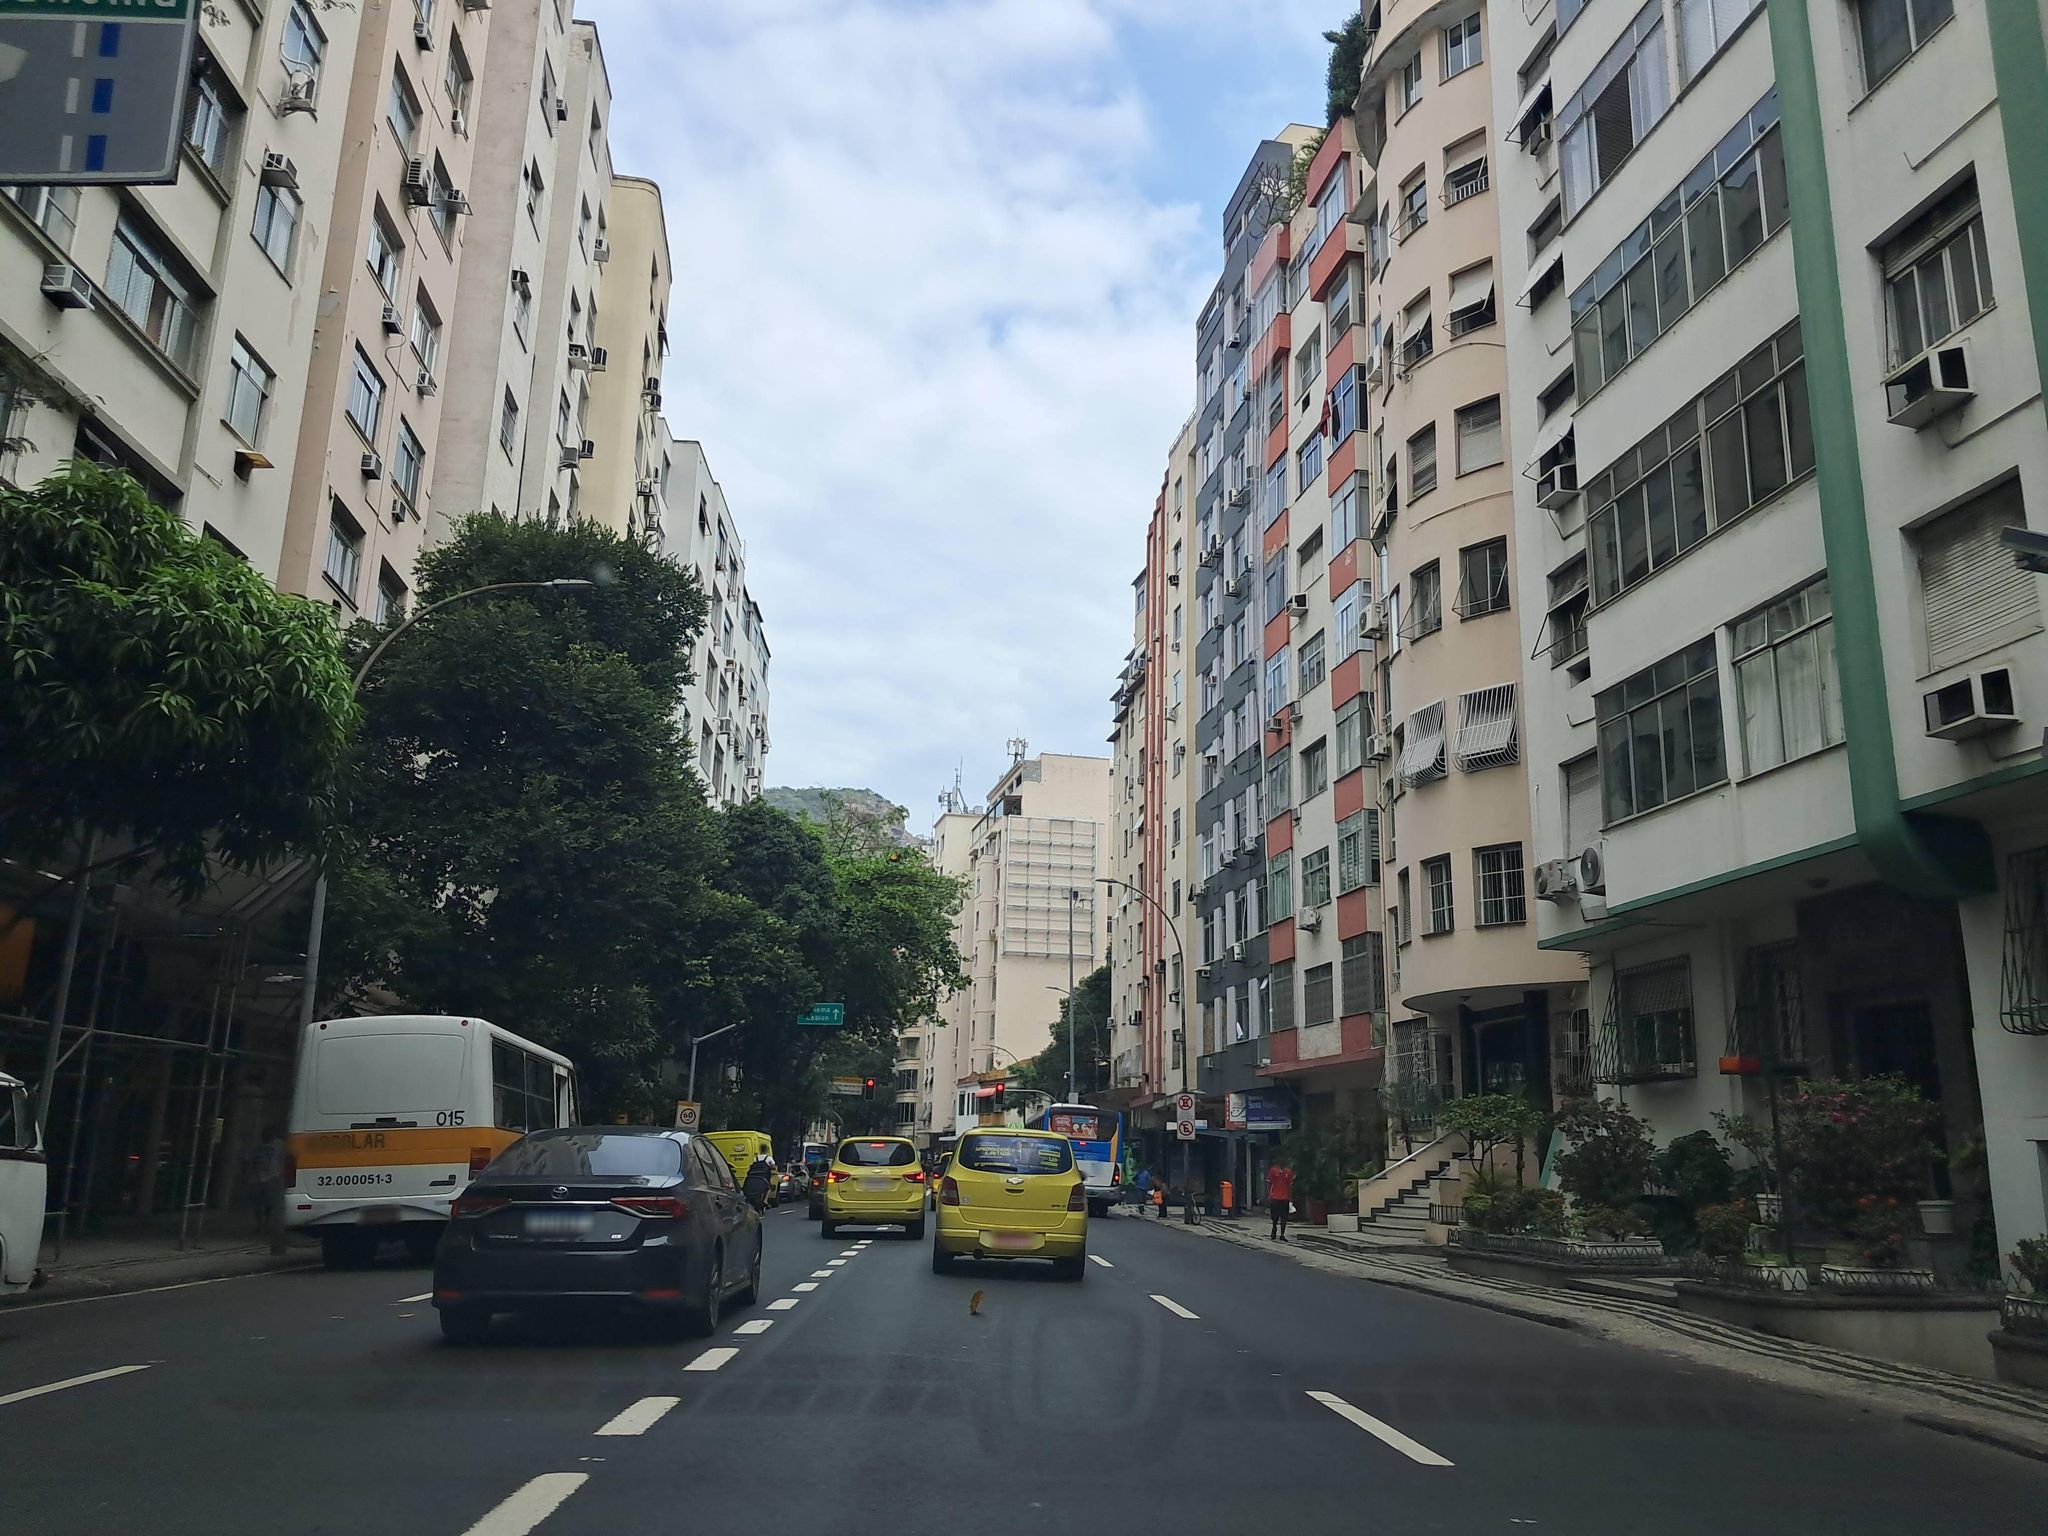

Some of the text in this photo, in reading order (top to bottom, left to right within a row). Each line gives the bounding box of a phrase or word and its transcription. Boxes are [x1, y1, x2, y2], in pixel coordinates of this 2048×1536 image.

[436, 1110, 465, 1126] 015
[683, 1111, 694, 1119] 60
[317, 1173, 393, 1187] 32.000051-3
